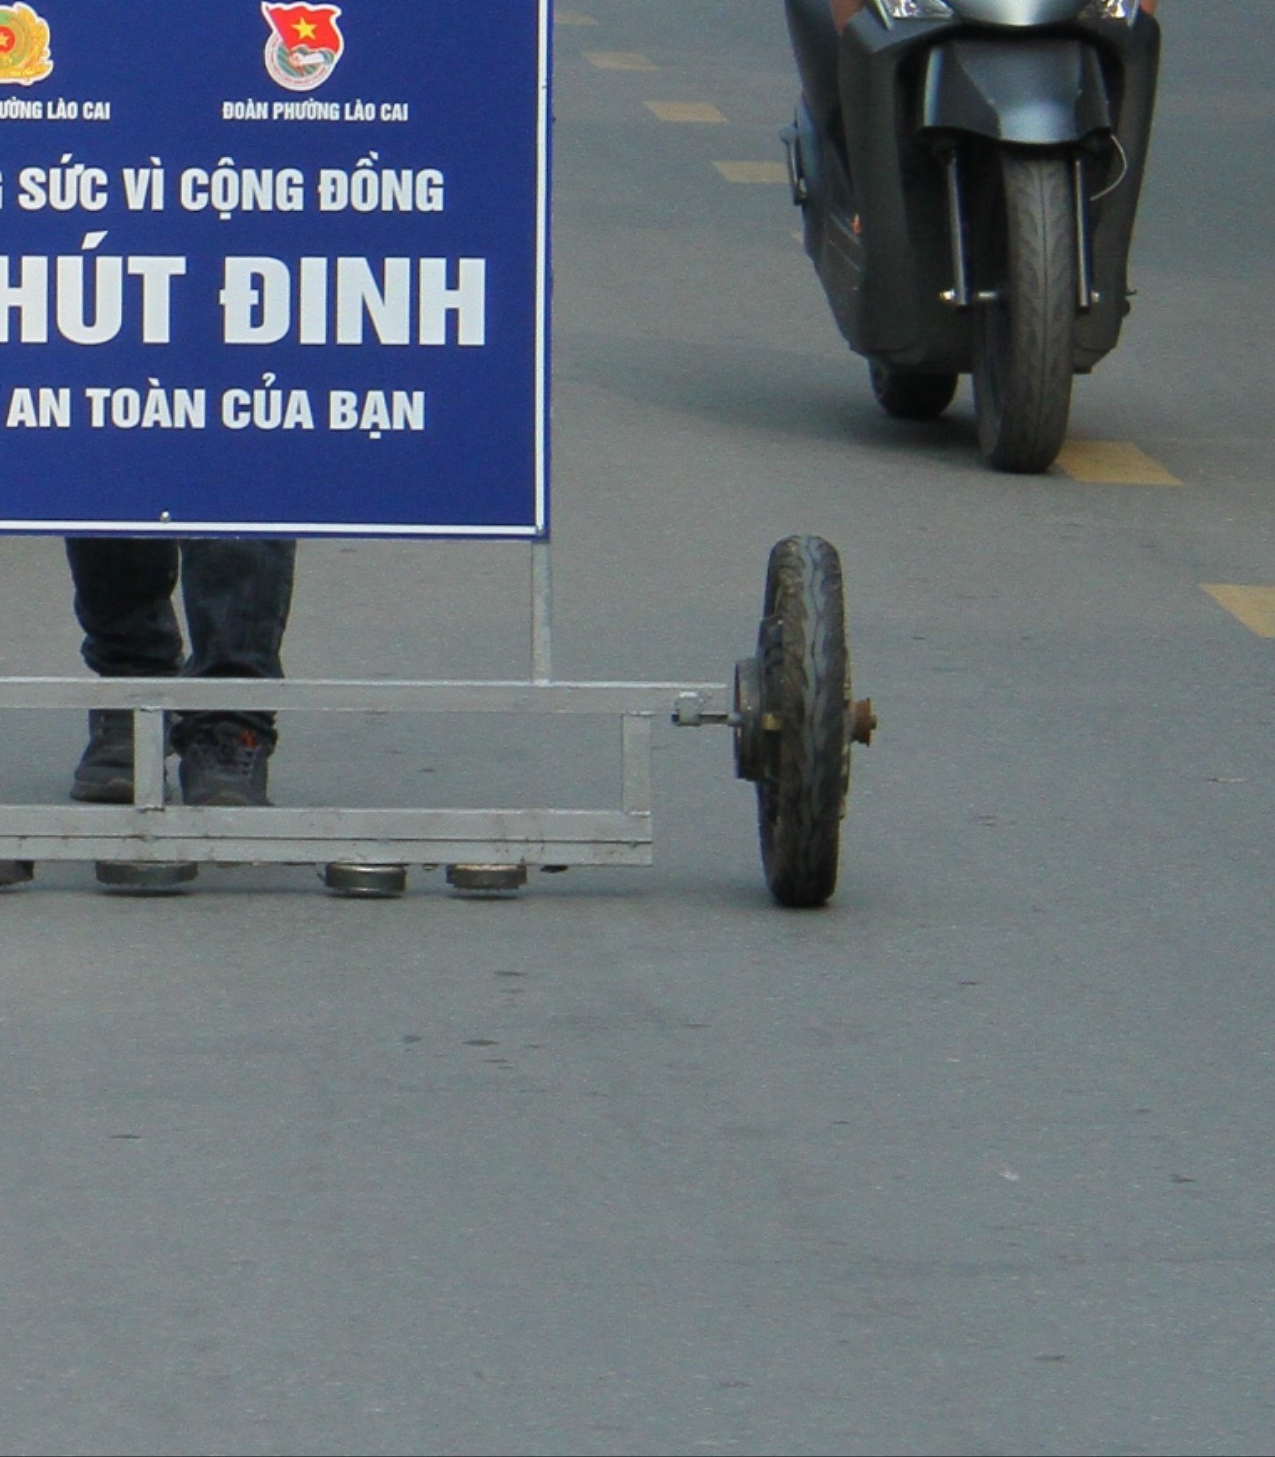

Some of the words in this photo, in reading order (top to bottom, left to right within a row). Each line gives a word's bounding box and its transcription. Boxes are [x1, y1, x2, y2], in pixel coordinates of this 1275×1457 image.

[47, 98, 78, 119] LÀO
[83, 102, 110, 119] CAI
[222, 98, 268, 119] ĐOÀN
[273, 98, 339, 120] PHƯỜNG
[344, 99, 375, 121] LÀO
[381, 103, 408, 121] CAI
[18, 154, 107, 211] SỨC
[123, 157, 164, 210] VÌ
[181, 157, 303, 219] CỘNG
[318, 151, 443, 211] ĐỒNG
[220, 257, 485, 345] ĐINH
[6, 388, 70, 427] AN
[86, 378, 205, 428] TOÀN
[222, 373, 314, 429] CỦA
[330, 391, 424, 439] BẠN
